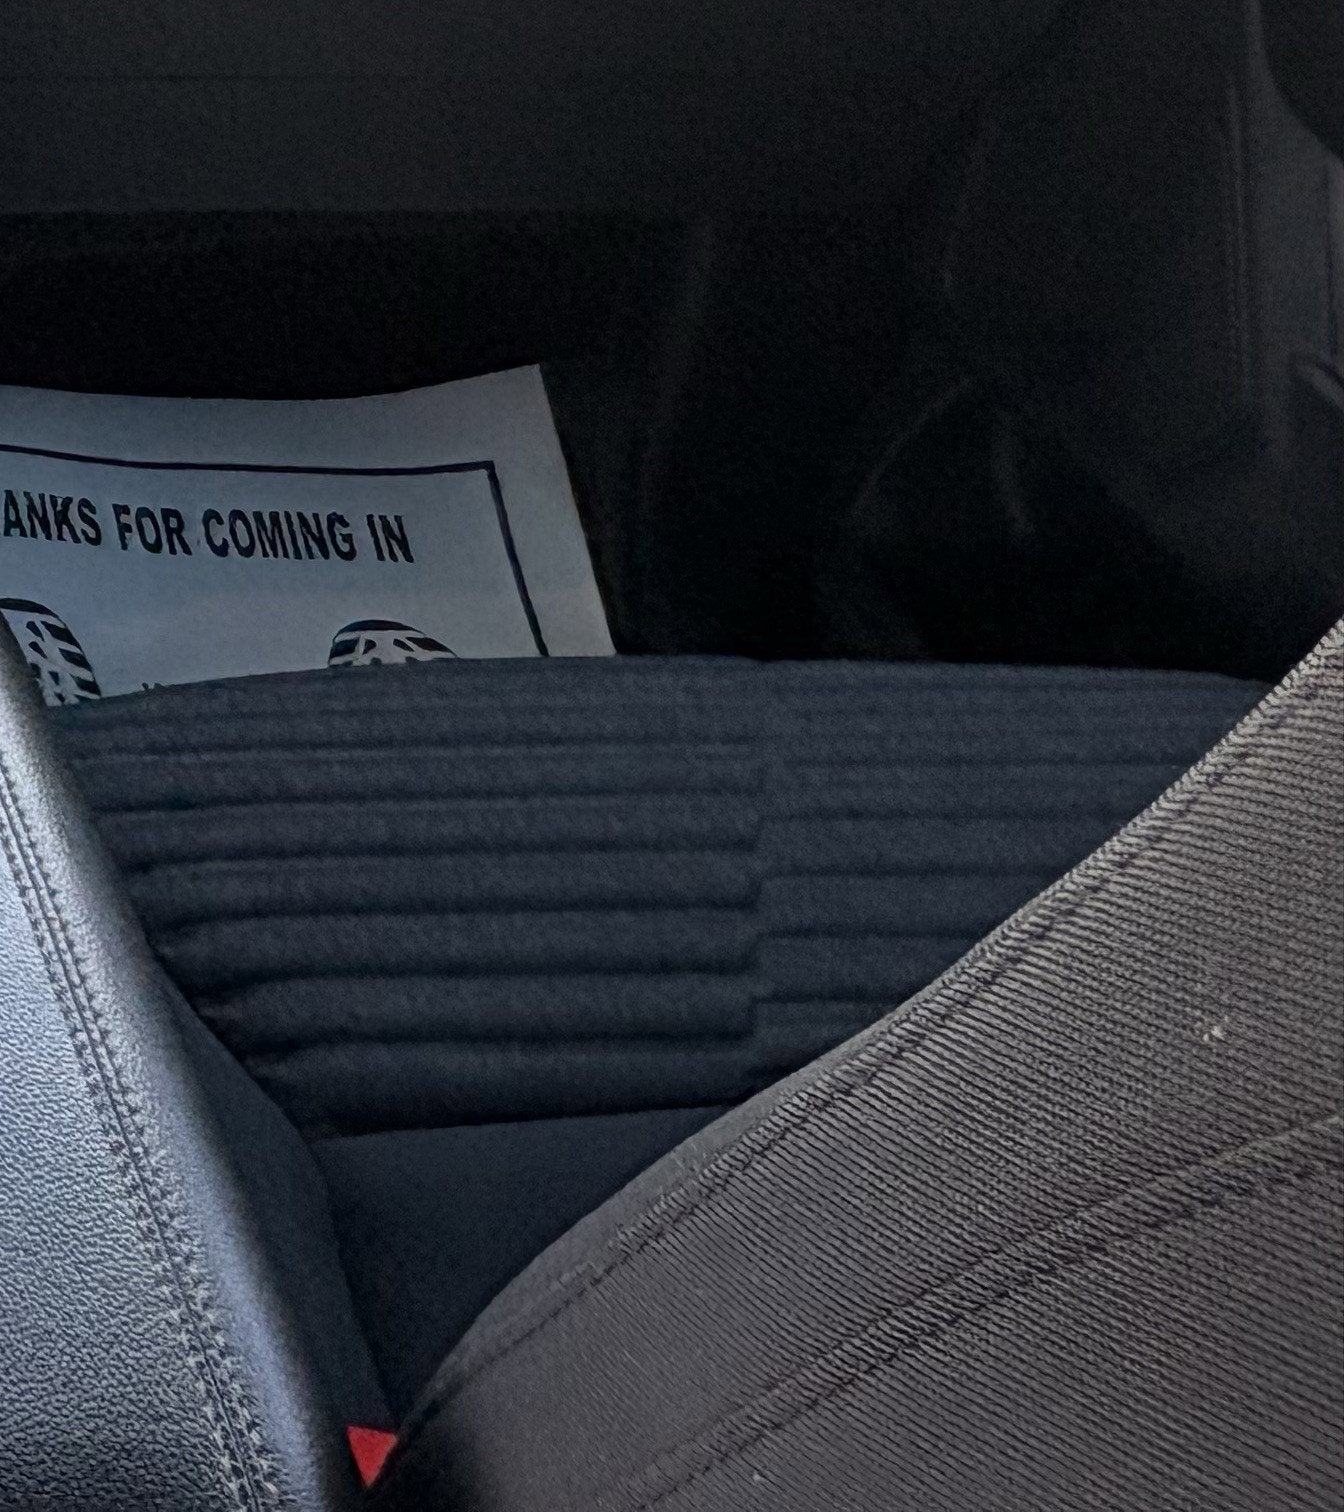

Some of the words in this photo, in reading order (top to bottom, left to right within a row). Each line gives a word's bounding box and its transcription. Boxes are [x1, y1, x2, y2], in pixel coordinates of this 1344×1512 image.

[112, 503, 193, 557] FOR
[201, 508, 358, 562] COMING
[366, 513, 415, 564] IN
